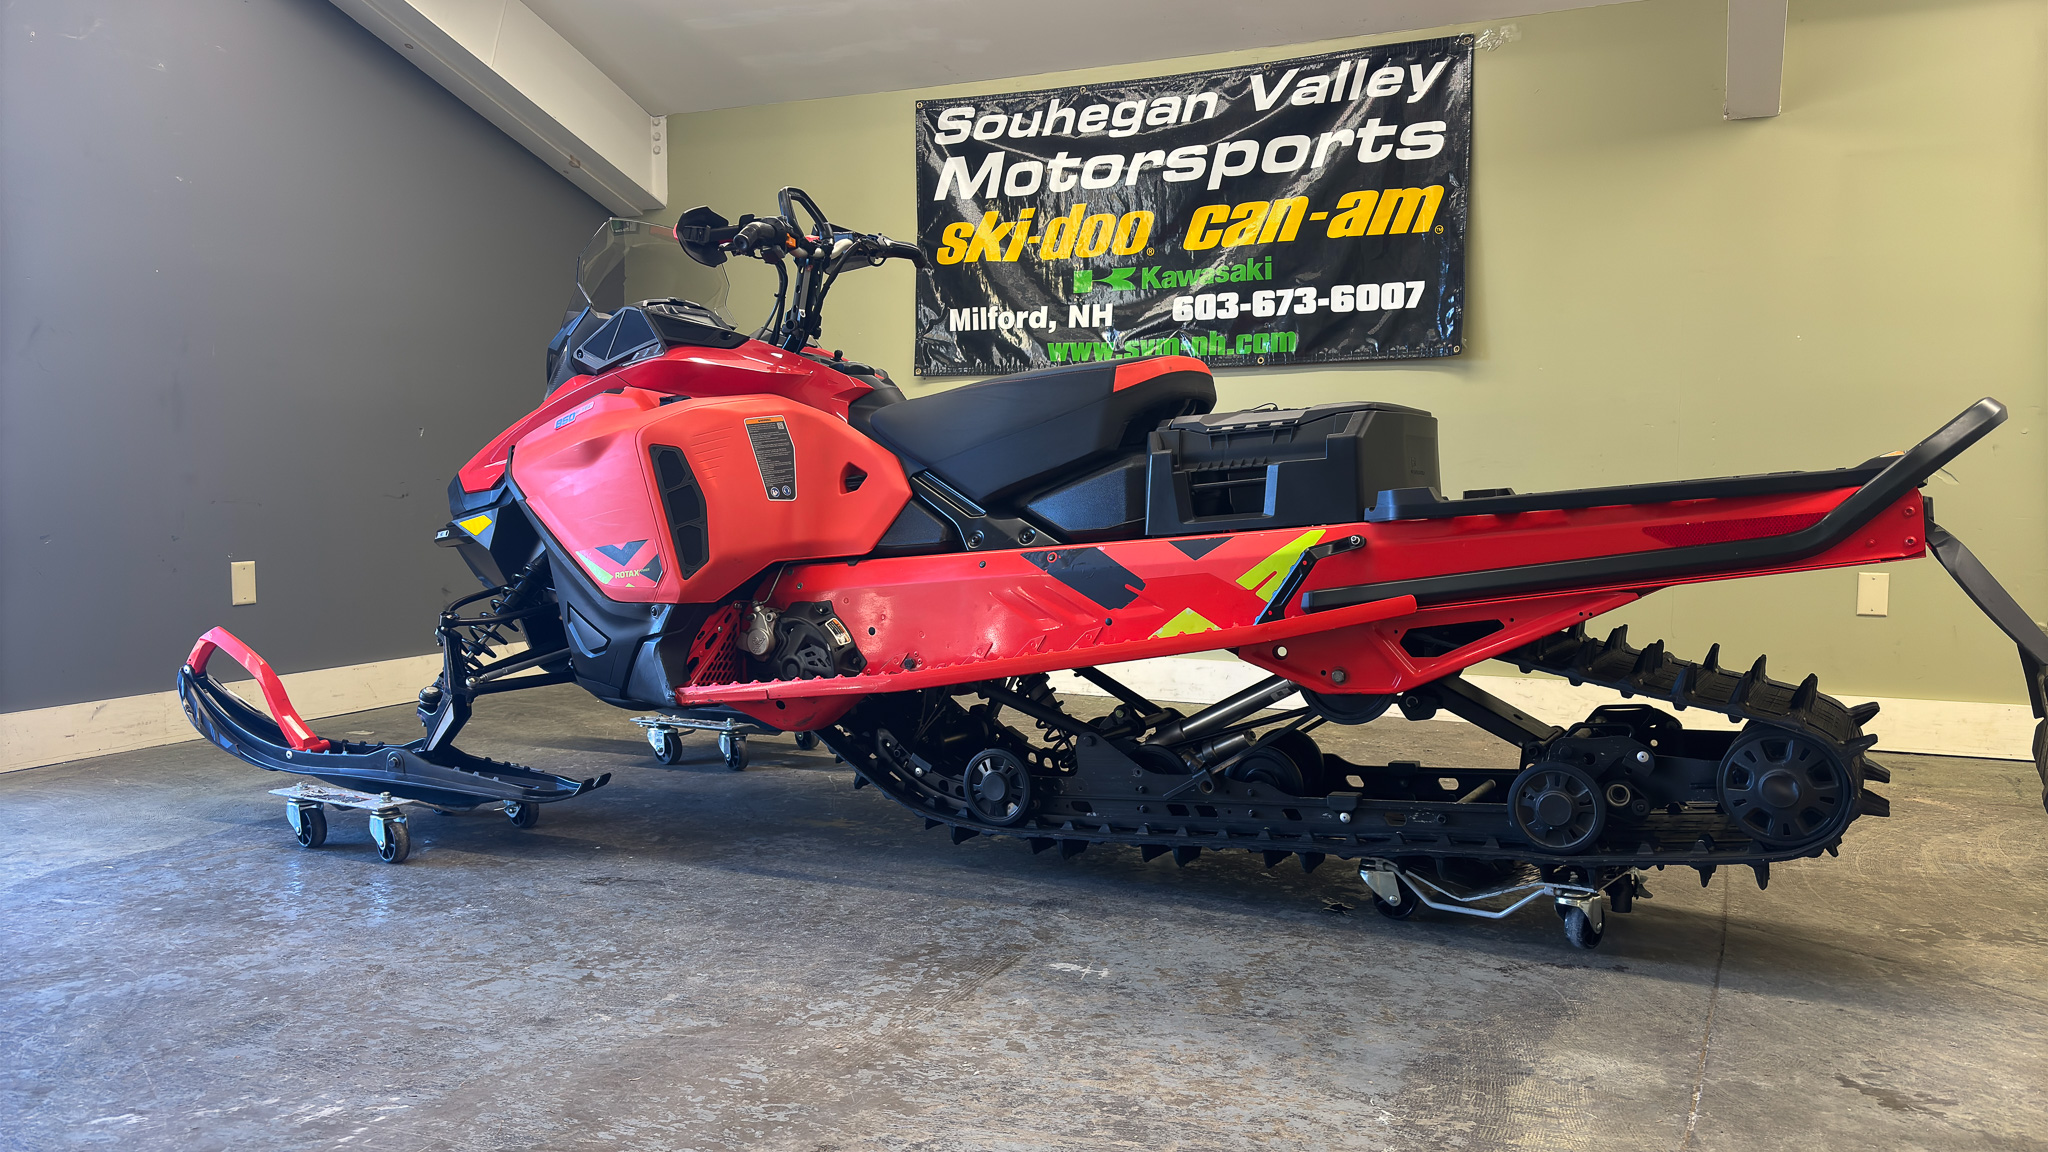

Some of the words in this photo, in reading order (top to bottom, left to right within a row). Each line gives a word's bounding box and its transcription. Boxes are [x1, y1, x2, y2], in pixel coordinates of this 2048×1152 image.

[934, 91, 1219, 145] Souhegan
[1250, 58, 1448, 112] Valley
[933, 117, 1447, 201] Motorsports
[936, 203, 1154, 265] ski-doo
[1183, 184, 1445, 250] can-am
[1141, 255, 1273, 290] Kawasaki
[950, 305, 1057, 333] Milford,
[1068, 303, 1114, 329] NH
[1172, 281, 1426, 322] 603-673-6007
[555, 412, 576, 429] 850
[615, 569, 640, 579] ROTAX
